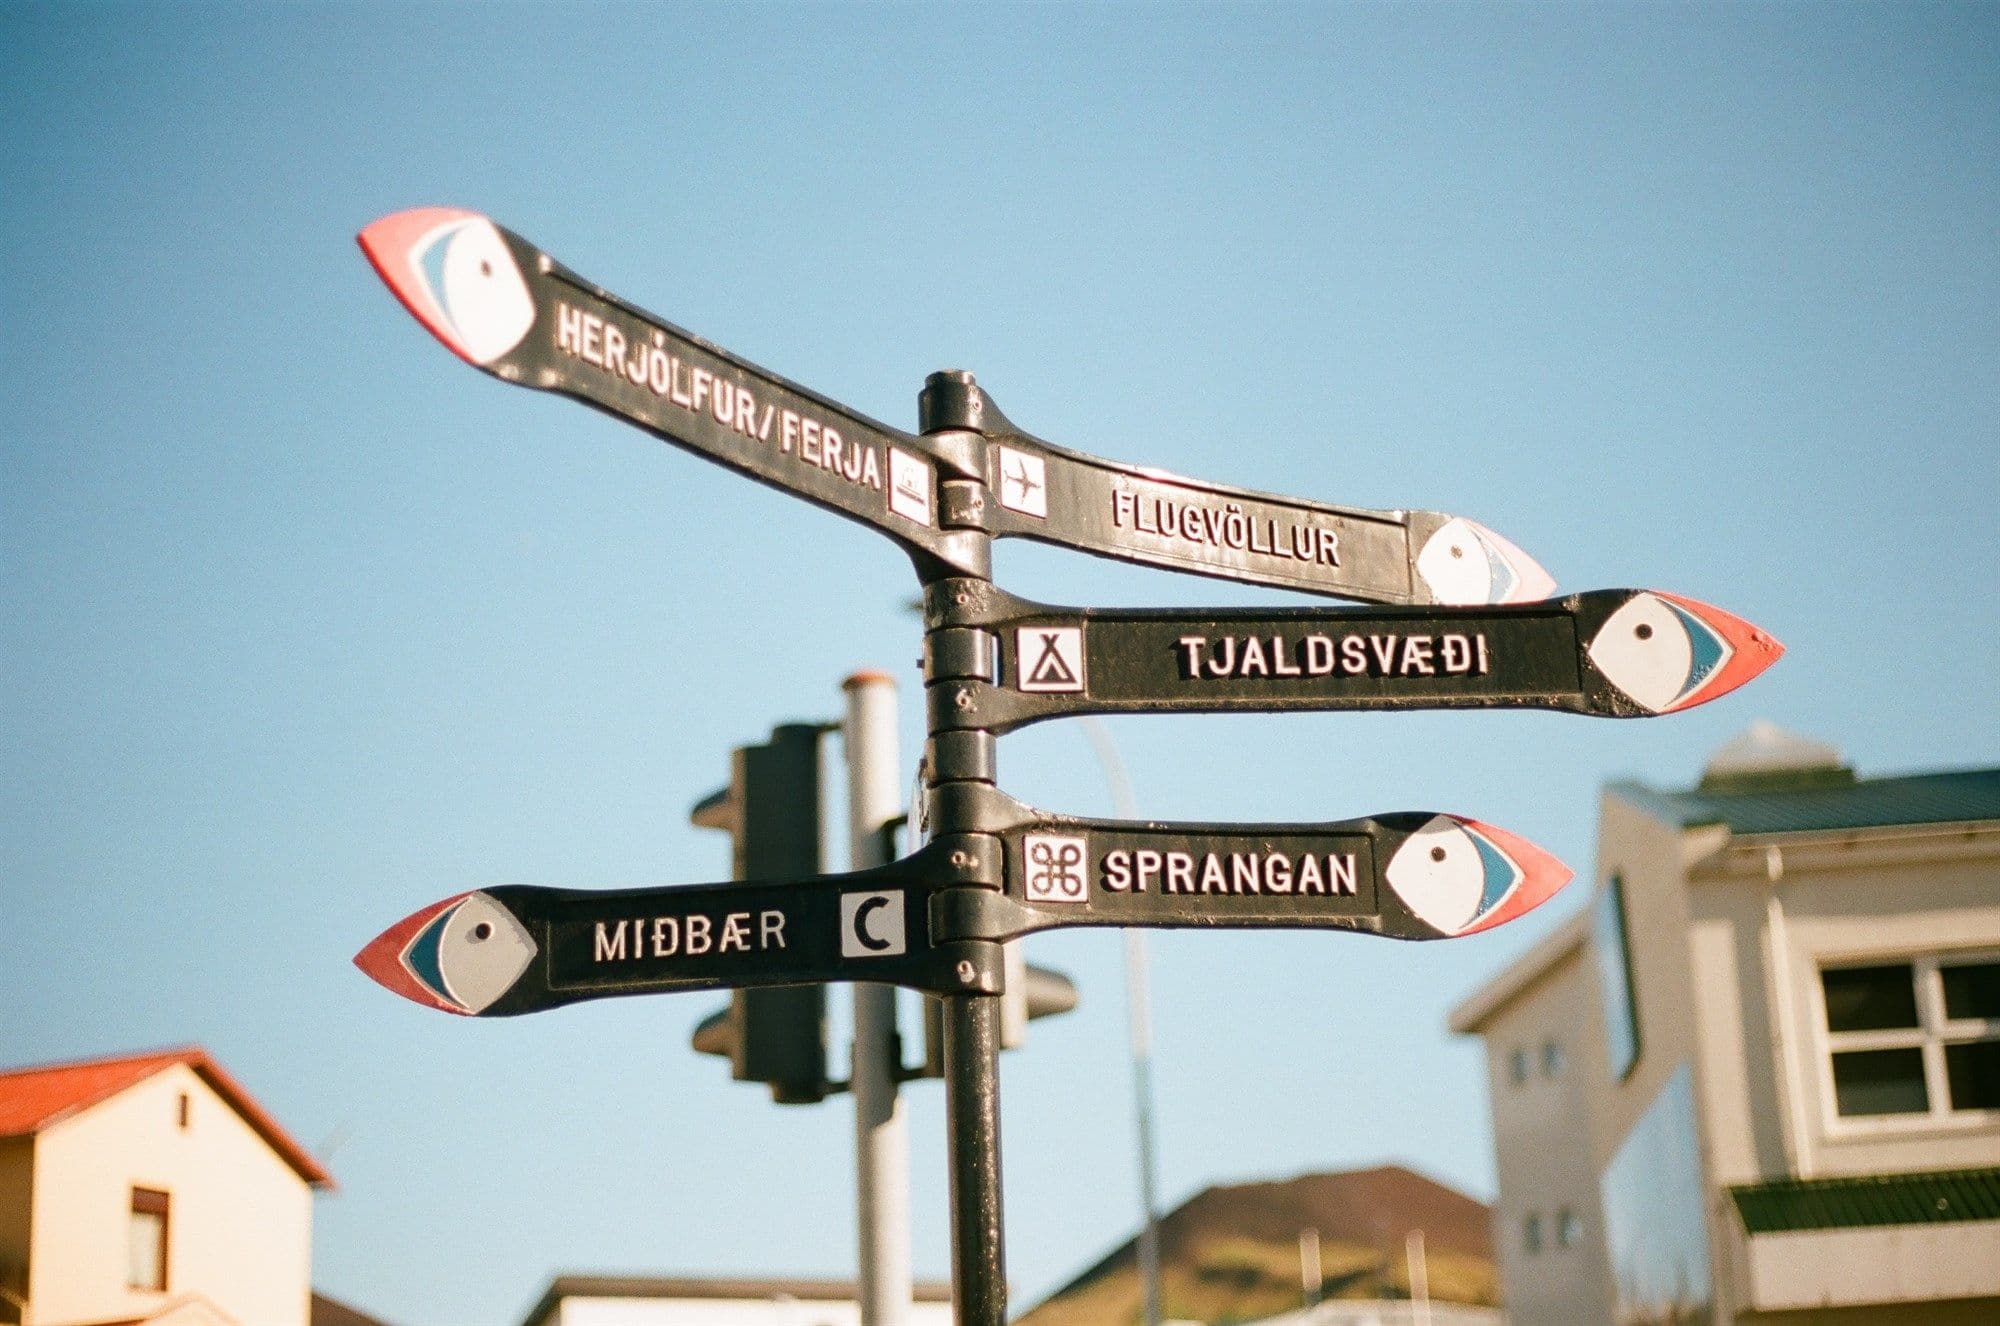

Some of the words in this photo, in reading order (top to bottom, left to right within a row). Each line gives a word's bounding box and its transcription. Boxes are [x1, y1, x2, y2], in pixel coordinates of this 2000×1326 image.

[1112, 489, 1341, 567] FLUGVÖLLUR
[1180, 633, 1490, 678] TJALDSVÆÐI
[1104, 850, 1357, 895] SPRANGAN
[594, 910, 787, 962] MIÐBÆR
